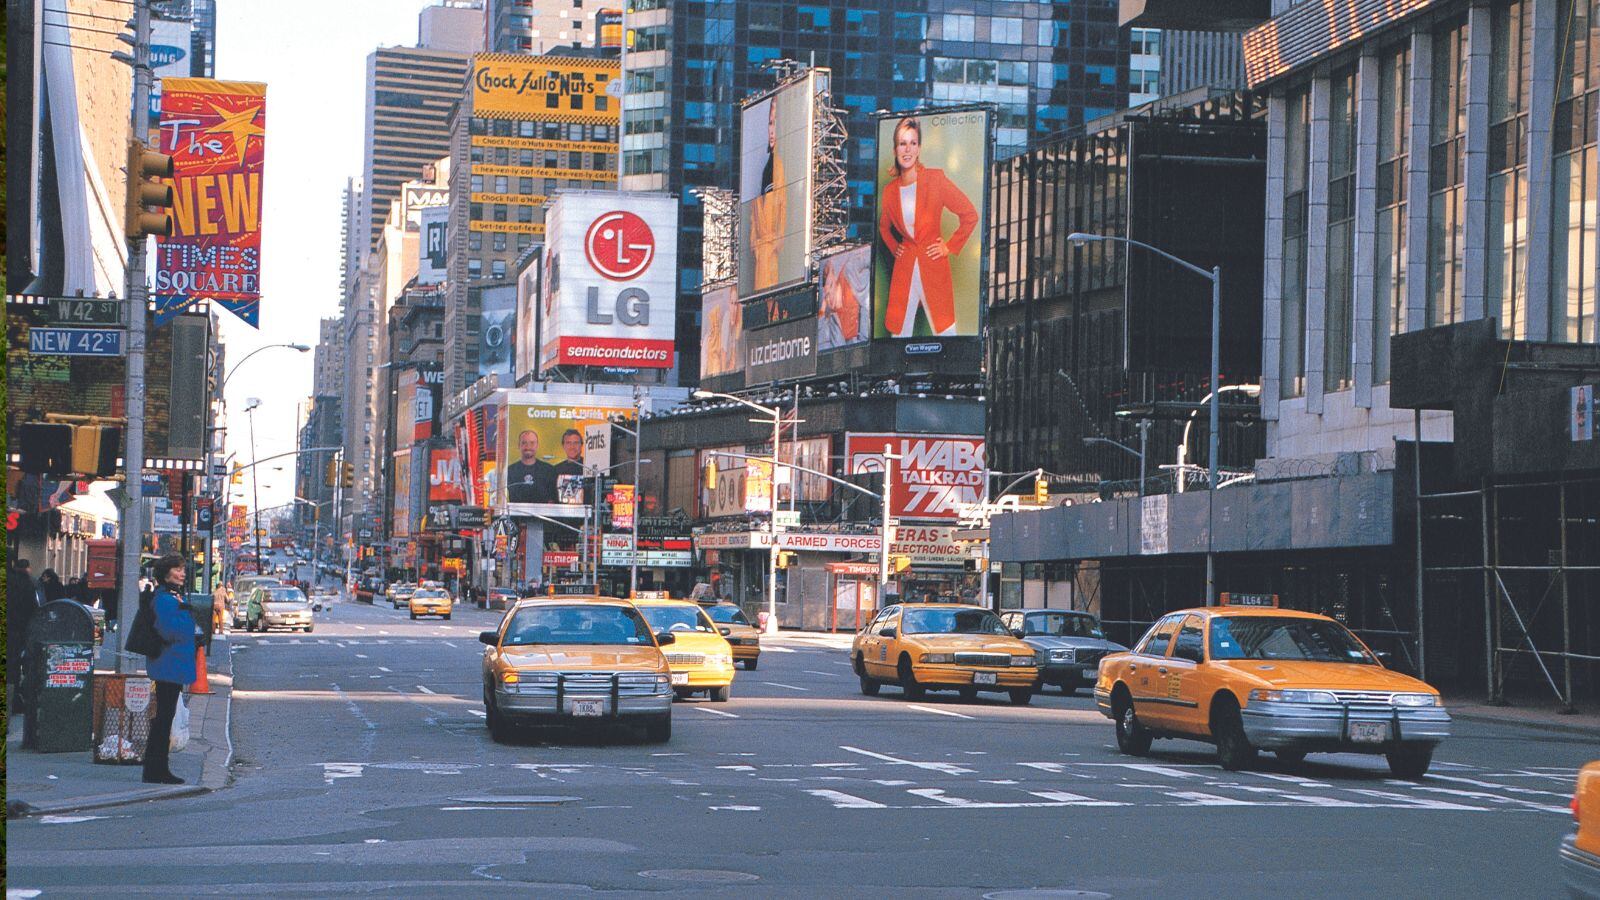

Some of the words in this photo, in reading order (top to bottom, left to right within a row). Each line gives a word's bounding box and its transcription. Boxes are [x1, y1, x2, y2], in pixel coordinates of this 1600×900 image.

[150, 52, 176, 63] UNG
[476, 66, 517, 93] Chock
[931, 113, 984, 127] Collection
[160, 119, 223, 157] The
[482, 137, 504, 146] Chock
[507, 138, 519, 146] full
[555, 141, 570, 149] that
[595, 172, 618, 180] cof-fe
[161, 172, 259, 237] NEW
[481, 194, 504, 202] Chock
[506, 194, 519, 202] full
[157, 243, 258, 271] TIMES
[157, 269, 258, 296] SQUARE
[58, 301, 71, 320] W
[74, 302, 93, 321] 42
[101, 302, 113, 313] ST
[587, 286, 650, 326] LG
[31, 331, 71, 352] NEW
[78, 332, 104, 352] 42
[105, 333, 117, 345] ST
[764, 336, 811, 364] claiborne
[567, 344, 668, 361] semiconductors
[527, 407, 557, 418] Come
[559, 407, 577, 418] Eat
[787, 536, 828, 547] ARMED
[834, 538, 881, 549] FORCES
[896, 527, 938, 542] ERAS
[891, 544, 960, 555] ELECTRONICS
